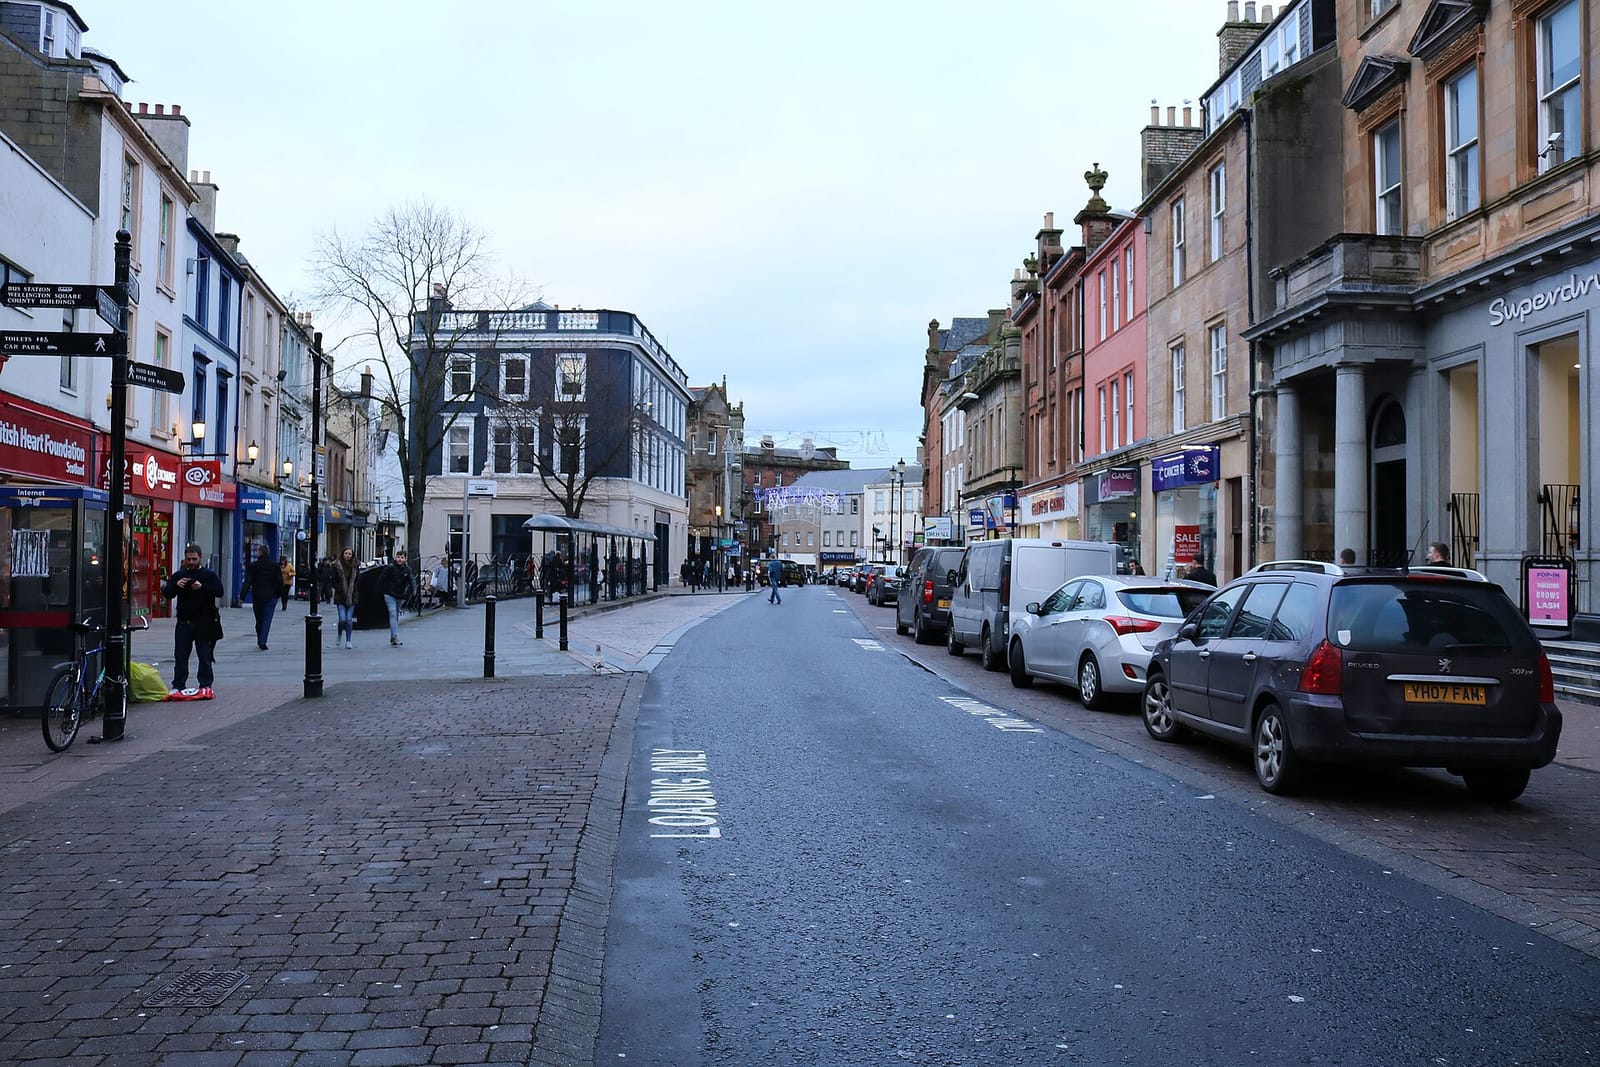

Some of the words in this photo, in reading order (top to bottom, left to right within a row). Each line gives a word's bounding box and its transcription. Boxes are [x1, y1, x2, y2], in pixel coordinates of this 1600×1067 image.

[20, 426, 44, 453] Heart
[44, 433, 85, 463] Foundation
[1111, 472, 1133, 480] GAME
[1163, 464, 1180, 478] CANCER
[1176, 534, 1200, 542] SALE
[1535, 591, 1561, 599] BROWS
[1536, 601, 1561, 609] LASH
[1412, 686, 1448, 699] YH07
[1452, 687, 1480, 701] FAM
[649, 748, 708, 773] ONLY
[647, 778, 722, 838] LOADING
